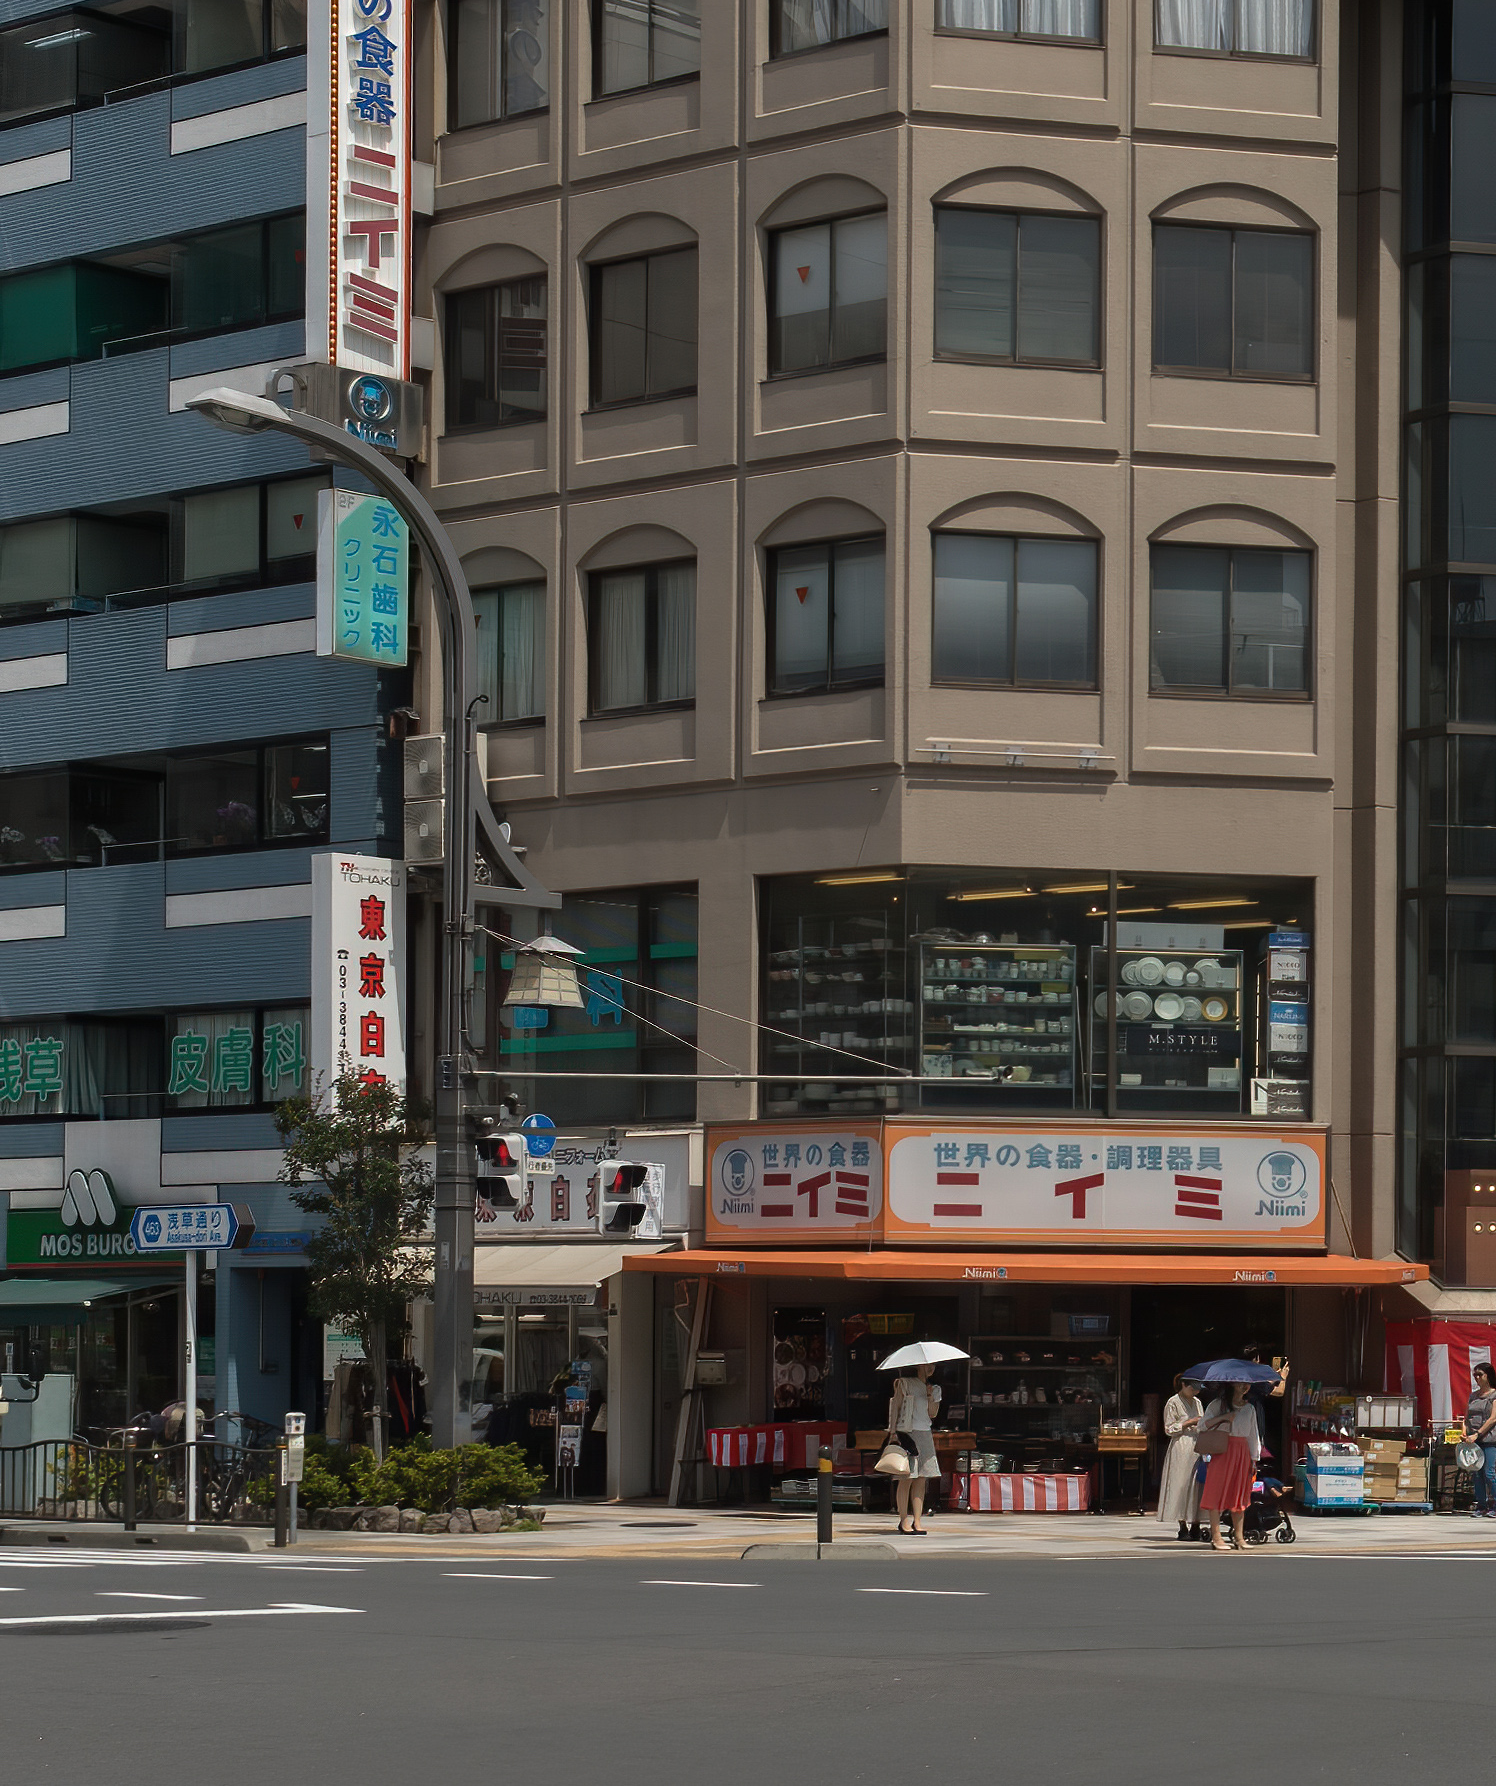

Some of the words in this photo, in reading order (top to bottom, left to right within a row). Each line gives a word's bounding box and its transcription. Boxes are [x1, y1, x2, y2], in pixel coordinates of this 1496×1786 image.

[346, 144, 399, 343] ニイミ
[371, 505, 400, 654] 永石歯科
[343, 538, 361, 647] クリニック
[341, 871, 400, 887] TOHAKU
[1149, 1034, 1218, 1046] M.STYLE
[168, 1020, 307, 1097] 皮膚科
[548, 1145, 608, 1165] ニフォーム
[761, 1141, 871, 1169] 世界の食器
[933, 1142, 1223, 1172] 世界の食器・調理器具
[720, 1196, 755, 1215] Niimi
[761, 1170, 870, 1218] ニイミ
[933, 1171, 1223, 1221] ニイミ
[1254, 1196, 1307, 1218] Niimi
[167, 1210, 222, 1230] 浅草通り
[40, 1234, 83, 1257] MOS
[86, 1232, 160, 1256] BURG
[962, 1267, 997, 1279] Niimi
[1232, 1270, 1265, 1282] Niimi
